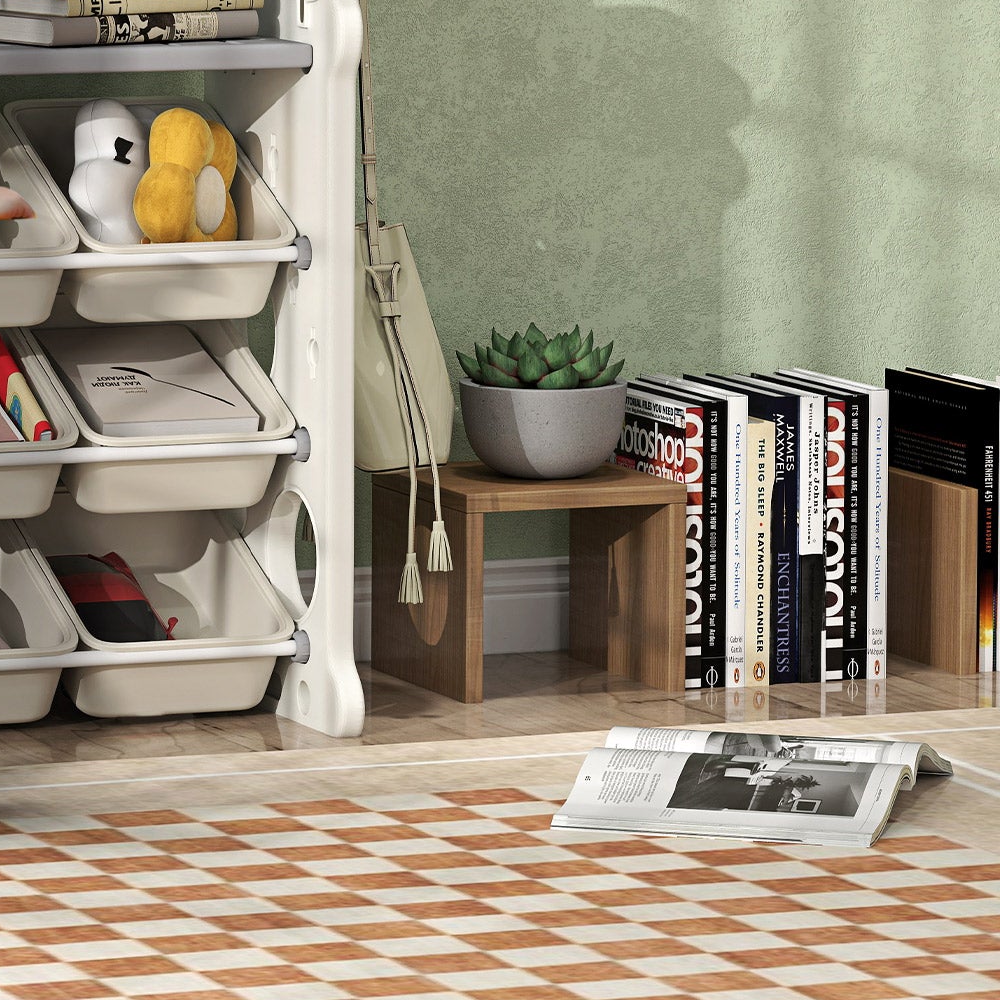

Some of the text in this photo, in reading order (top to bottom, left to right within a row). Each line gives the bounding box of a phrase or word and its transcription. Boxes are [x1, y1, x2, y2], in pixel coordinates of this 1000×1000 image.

[710, 411, 718, 423] IT'S
[851, 404, 859, 417] IT'S
[710, 425, 718, 436] NOT
[851, 419, 859, 430] NOT
[710, 439, 718, 452] HOW
[851, 432, 859, 446] HOW
[776, 413, 785, 483] MAXWELL
[786, 424, 795, 471] JAMES
[710, 455, 718, 471] GOOD
[850, 448, 858, 464] GOOD
[710, 473, 718, 485] YOU
[850, 466, 858, 478] YOU
[984, 445, 993, 502] FAHRENHEIT 451
[709, 503, 717, 514] IT'S
[757, 487, 765, 516] SLEEP
[850, 496, 858, 507] IT'S
[850, 509, 858, 522] HOW
[709, 516, 717, 530] HOW
[734, 544, 741, 557] of
[875, 537, 881, 551] of
[850, 556, 858, 574] WANT
[709, 564, 717, 582] WANT
[850, 575, 858, 584] TO
[777, 552, 790, 673] ENCHANTRESS
[708, 628, 716, 647] Arden
